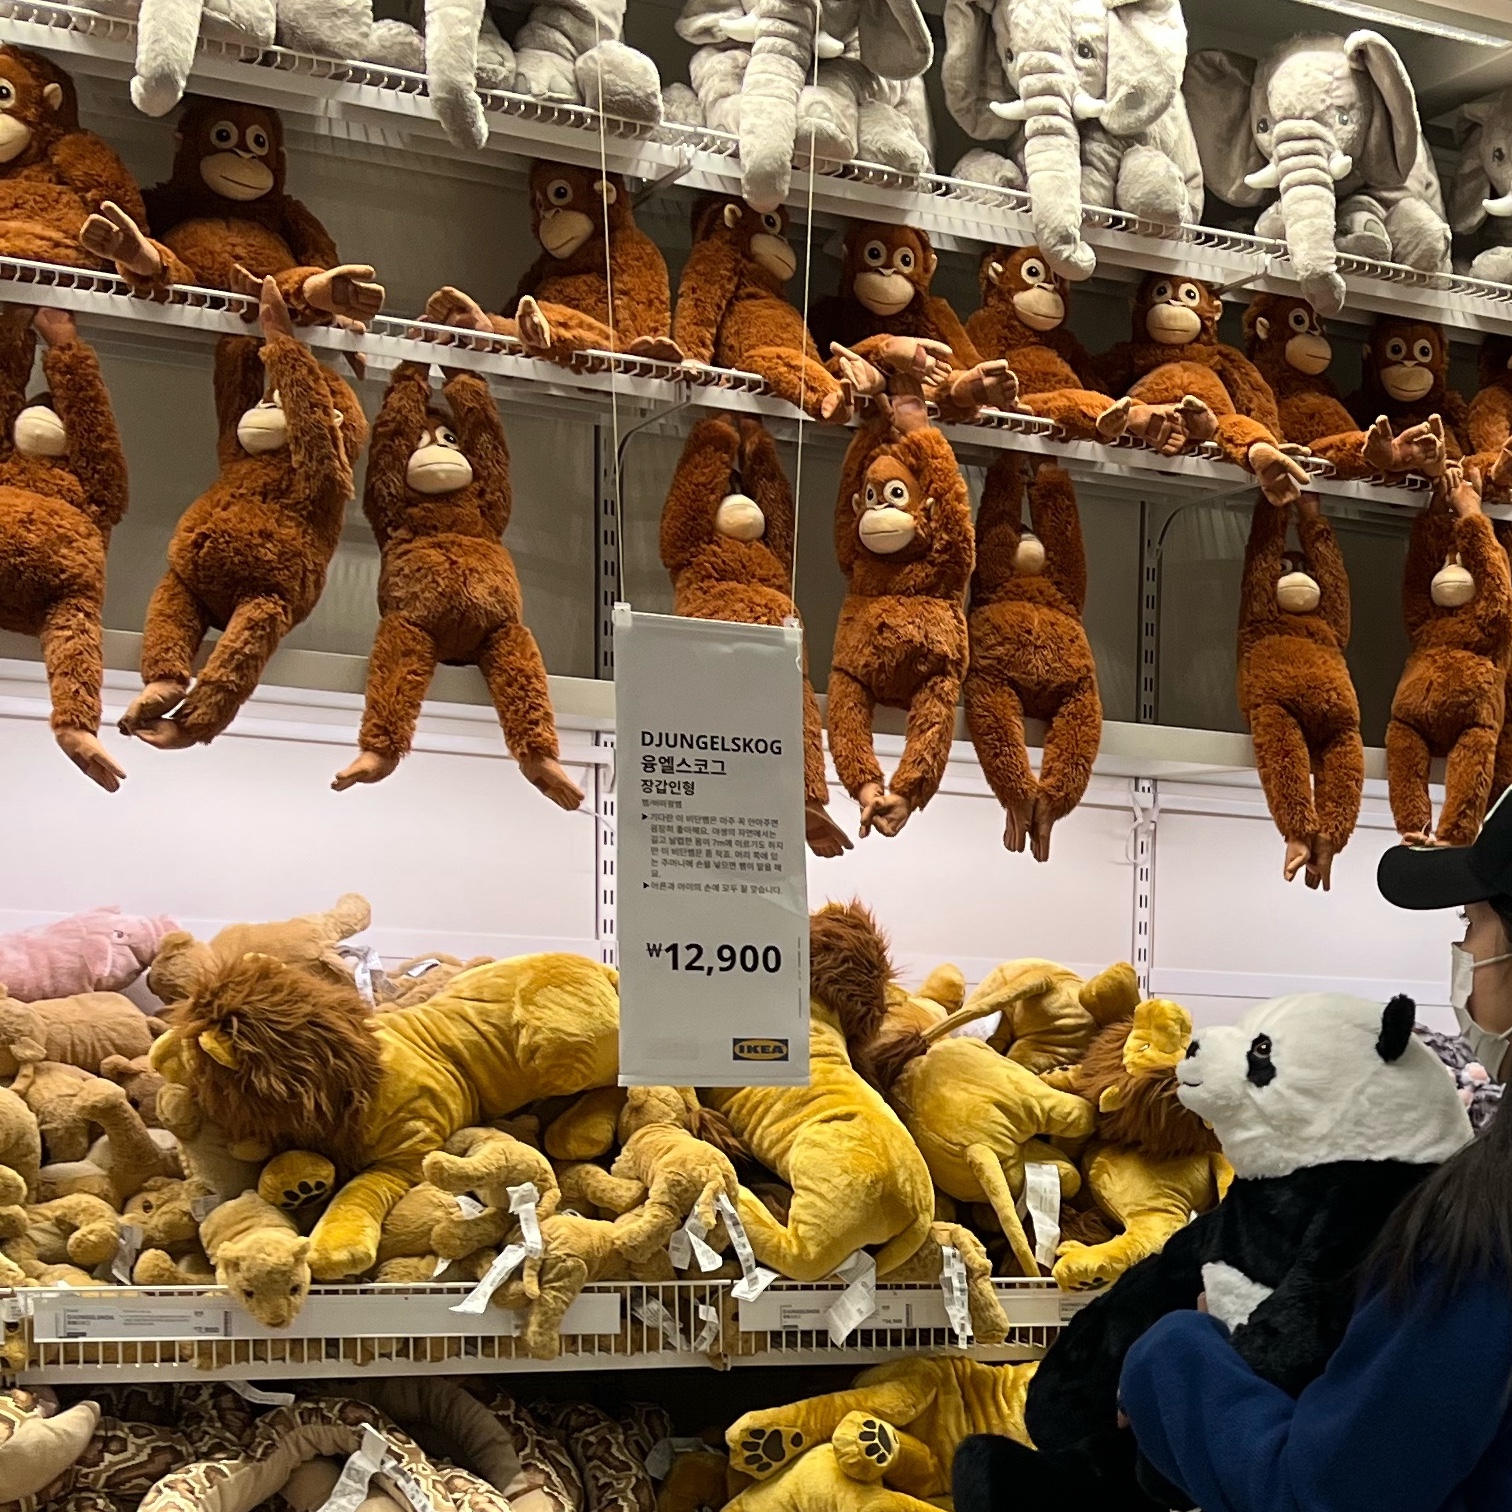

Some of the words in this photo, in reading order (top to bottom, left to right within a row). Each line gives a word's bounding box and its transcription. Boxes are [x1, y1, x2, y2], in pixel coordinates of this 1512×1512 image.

[641, 731, 782, 755] DJUNGELSKOG
[641, 754, 727, 775] 융엘스코그
[641, 779, 695, 796] 장갑인형
[738, 1044, 784, 1054] IKEA
